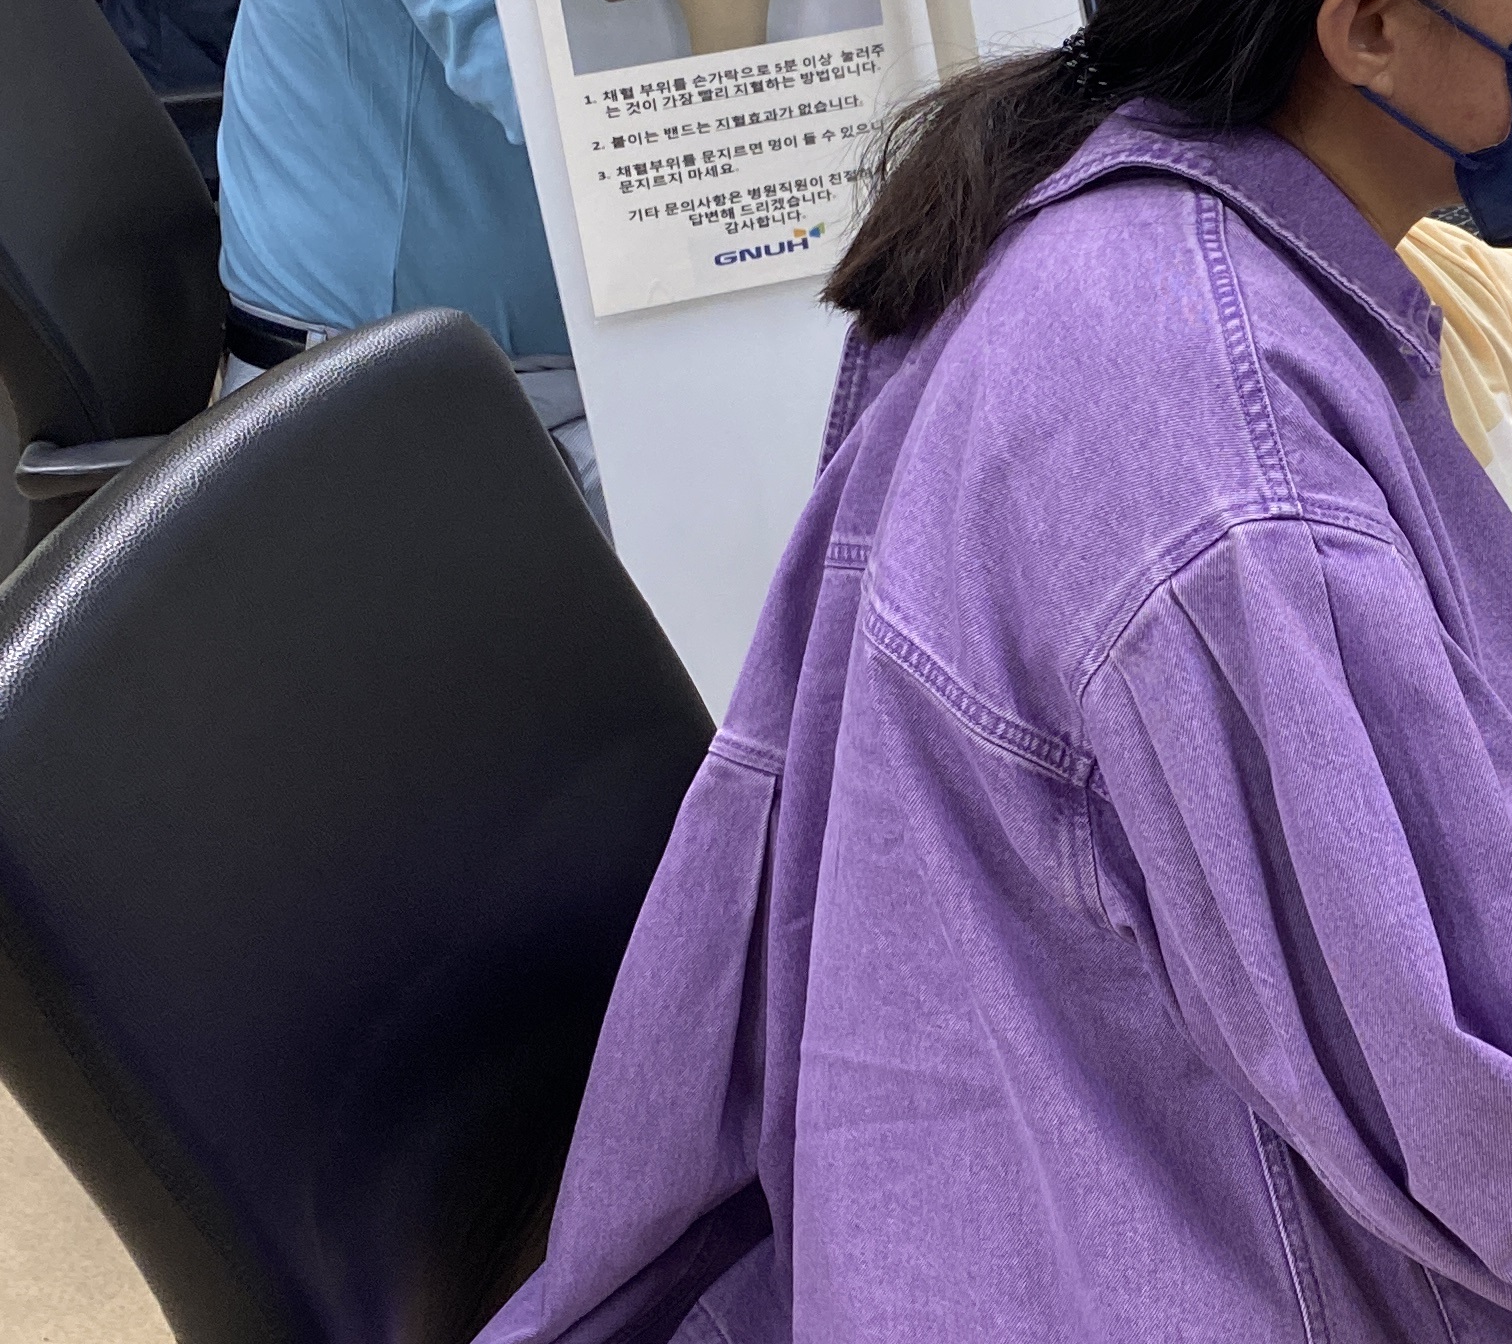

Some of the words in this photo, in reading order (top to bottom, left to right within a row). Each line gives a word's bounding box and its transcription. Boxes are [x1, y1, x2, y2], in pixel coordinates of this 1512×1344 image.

[584, 95, 597, 105] 1.
[603, 86, 635, 102] 채혈
[640, 77, 687, 97] 부위를
[692, 64, 771, 88] 손가락으로
[774, 59, 798, 73] 5분
[802, 52, 833, 69] 이상
[840, 43, 885, 63] 눌러주
[606, 105, 621, 119] 는
[626, 97, 657, 116] 것이
[662, 91, 694, 108] 가장
[697, 85, 729, 103] 빨리
[734, 75, 796, 95] 지혈하는
[800, 60, 882, 85] 방법입니다.
[592, 141, 606, 151] 2.
[611, 130, 659, 149] 붙이는
[663, 121, 711, 140] 밴드는
[715, 106, 794, 130] 지혈효과가
[798, 94, 864, 116] 없습니다.
[598, 171, 611, 181] 3.
[616, 153, 697, 178] 채혈부위를
[702, 141, 764, 164] 문지르면
[768, 135, 798, 152] 멍이
[803, 131, 817, 146] 들
[822, 129, 836, 142] 수
[619, 170, 683, 194] 문지르지
[688, 163, 739, 181] 마세요.
[628, 206, 660, 222] 기타
[664, 190, 743, 216] 문의사항은
[747, 175, 824, 200] 병원직원이
[688, 207, 735, 227] 답변해
[740, 189, 837, 216] 드리겠습니다.
[725, 209, 807, 235] 감사합니다.
[714, 237, 809, 266] GNUH
